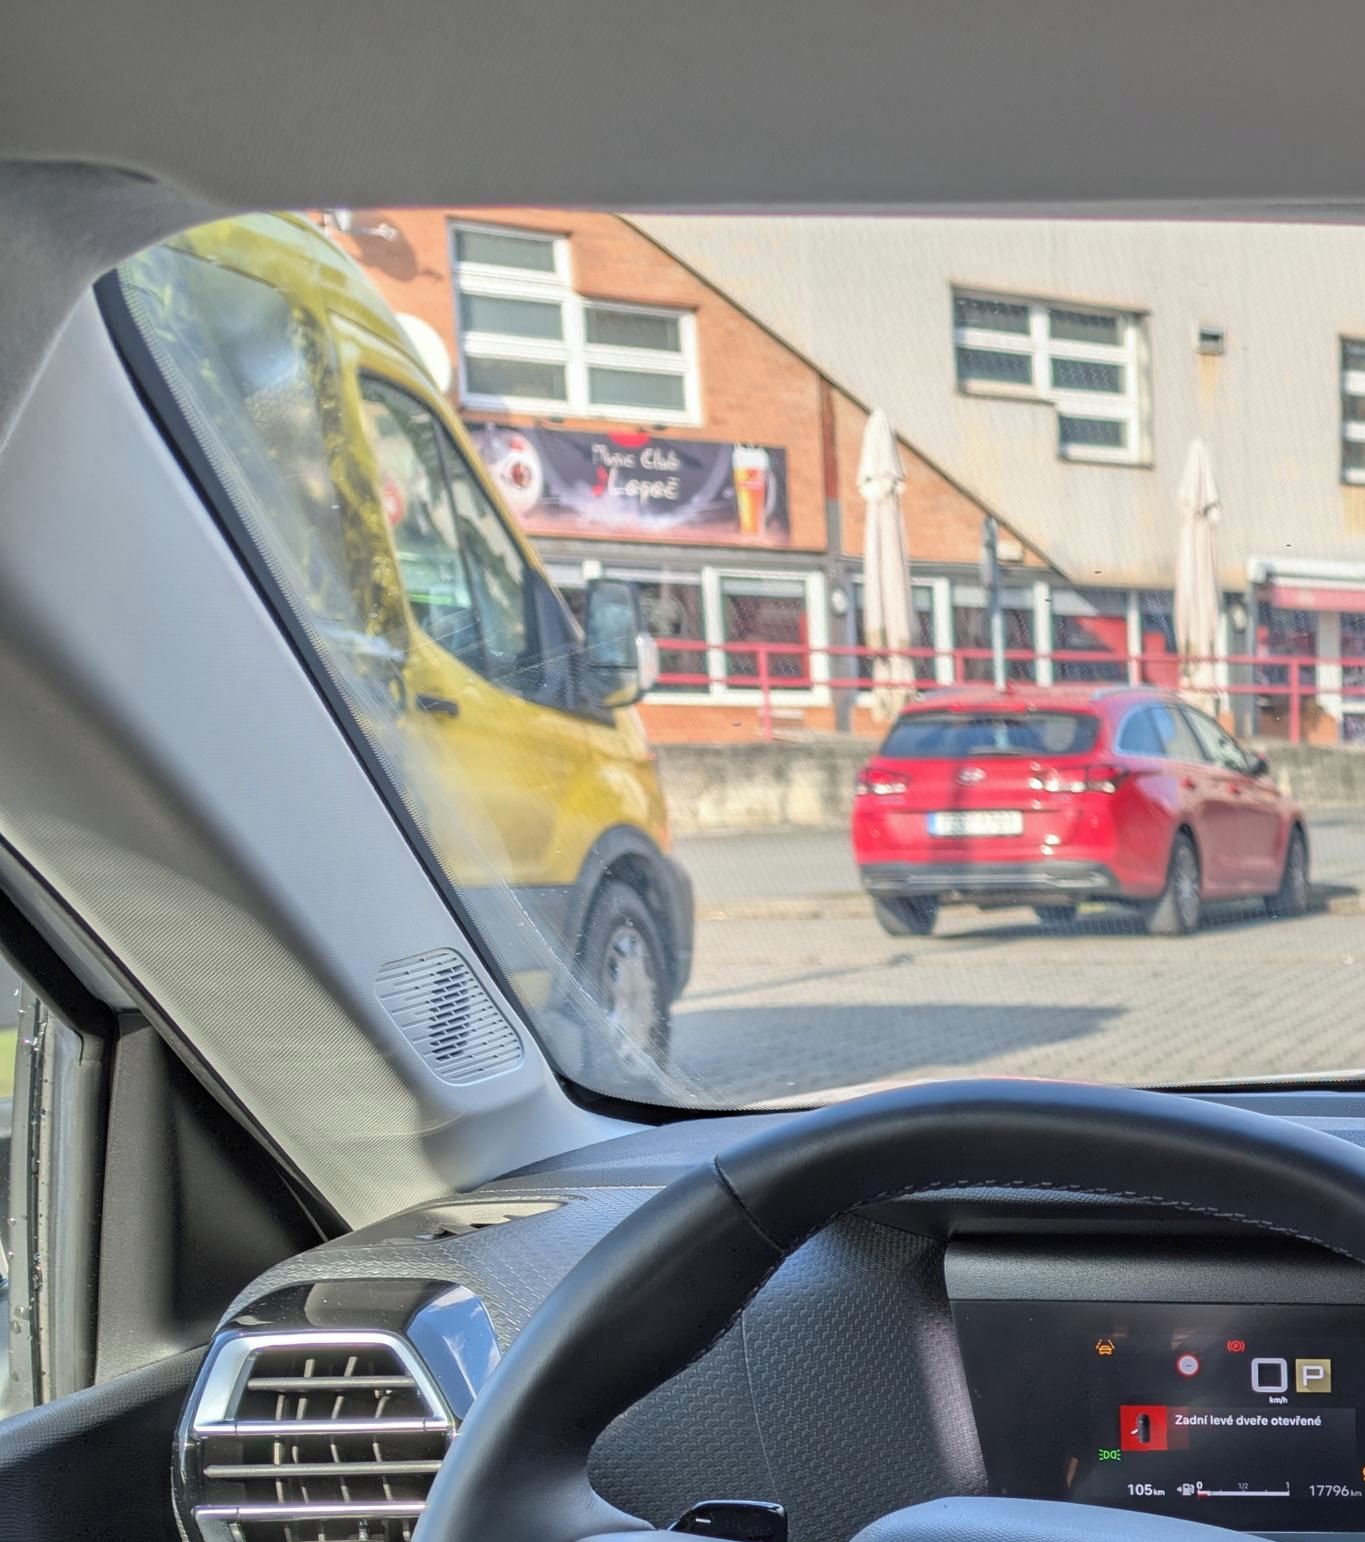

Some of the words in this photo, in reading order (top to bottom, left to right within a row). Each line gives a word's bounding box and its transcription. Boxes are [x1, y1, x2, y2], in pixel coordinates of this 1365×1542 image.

[640, 447, 682, 471] Club
[1269, 1396, 1289, 1404] km/h
[1175, 1414, 1209, 1426] Zadní
[1210, 1414, 1234, 1426] levé
[1236, 1415, 1269, 1426] dveře
[1271, 1415, 1322, 1426] otevřené
